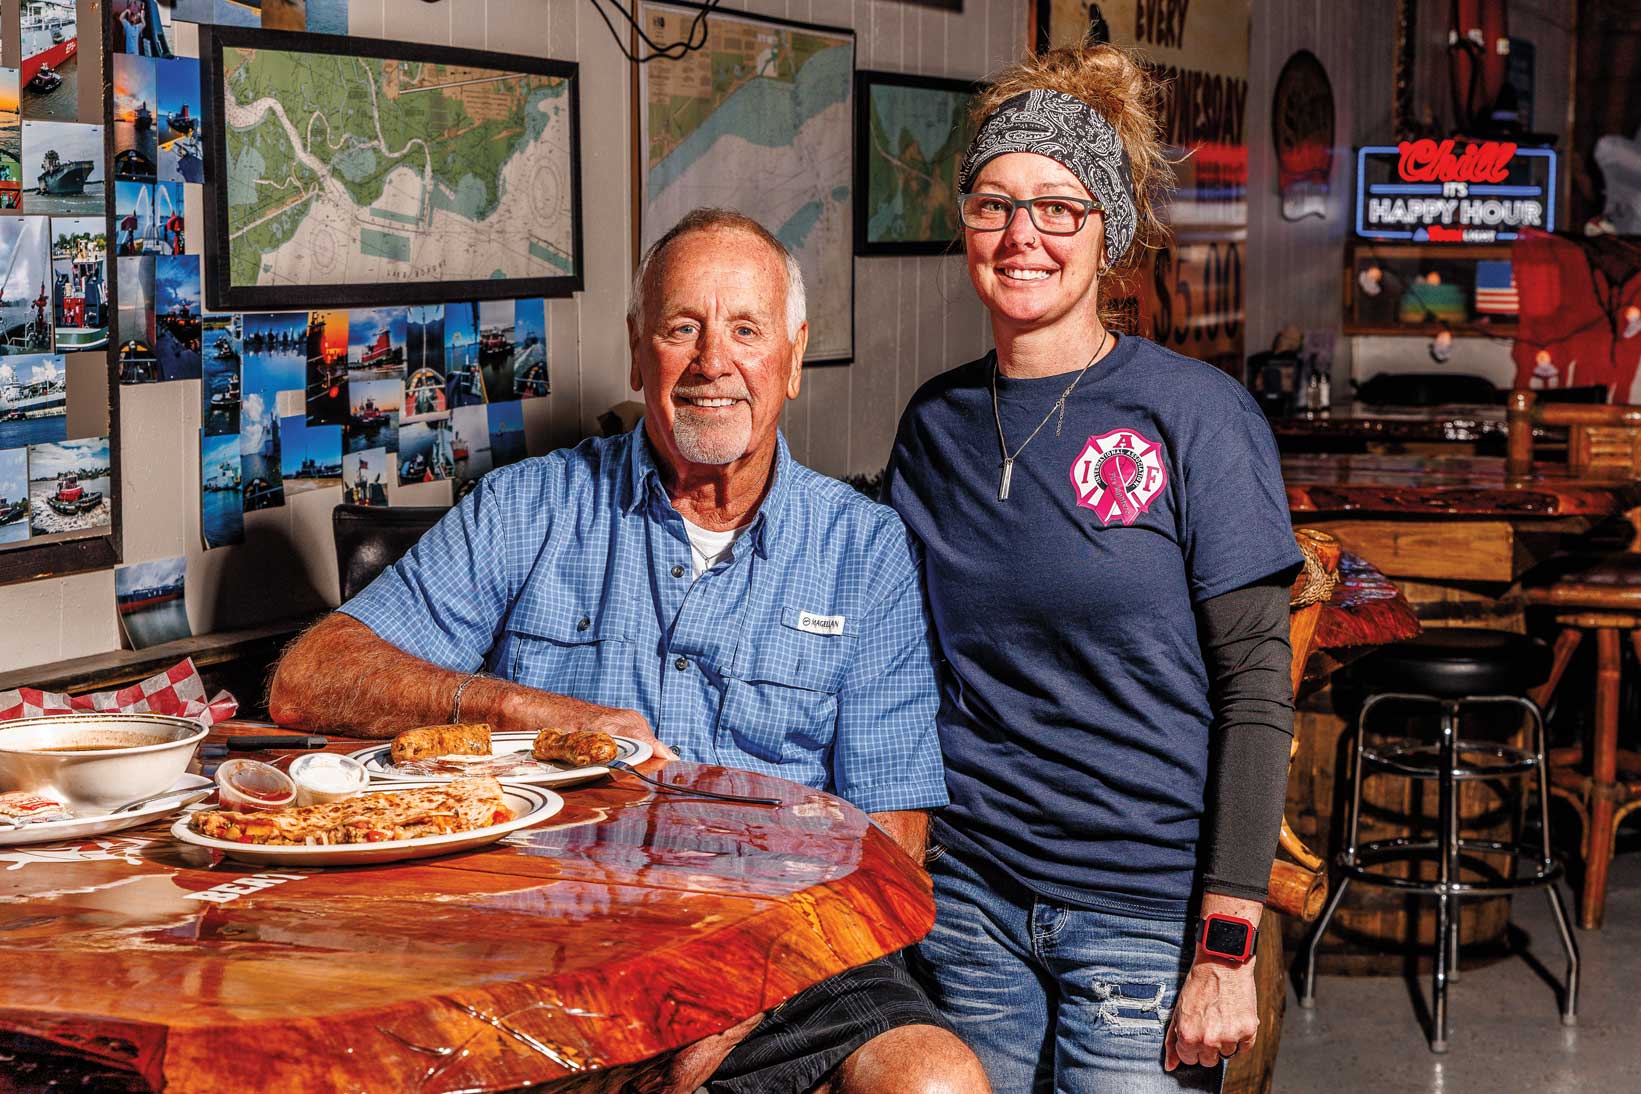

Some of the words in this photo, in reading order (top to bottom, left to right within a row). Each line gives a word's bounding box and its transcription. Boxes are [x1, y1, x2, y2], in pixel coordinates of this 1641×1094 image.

[1397, 138, 1518, 183] Chill
[1368, 197, 1458, 225] HAPPY
[1459, 199, 1542, 226] HOUR
[1153, 242, 1242, 345] $5.00
[1112, 434, 1135, 449] A
[1081, 460, 1092, 484] I
[1142, 465, 1160, 492] F
[811, 618, 840, 628] MAGELLAN
